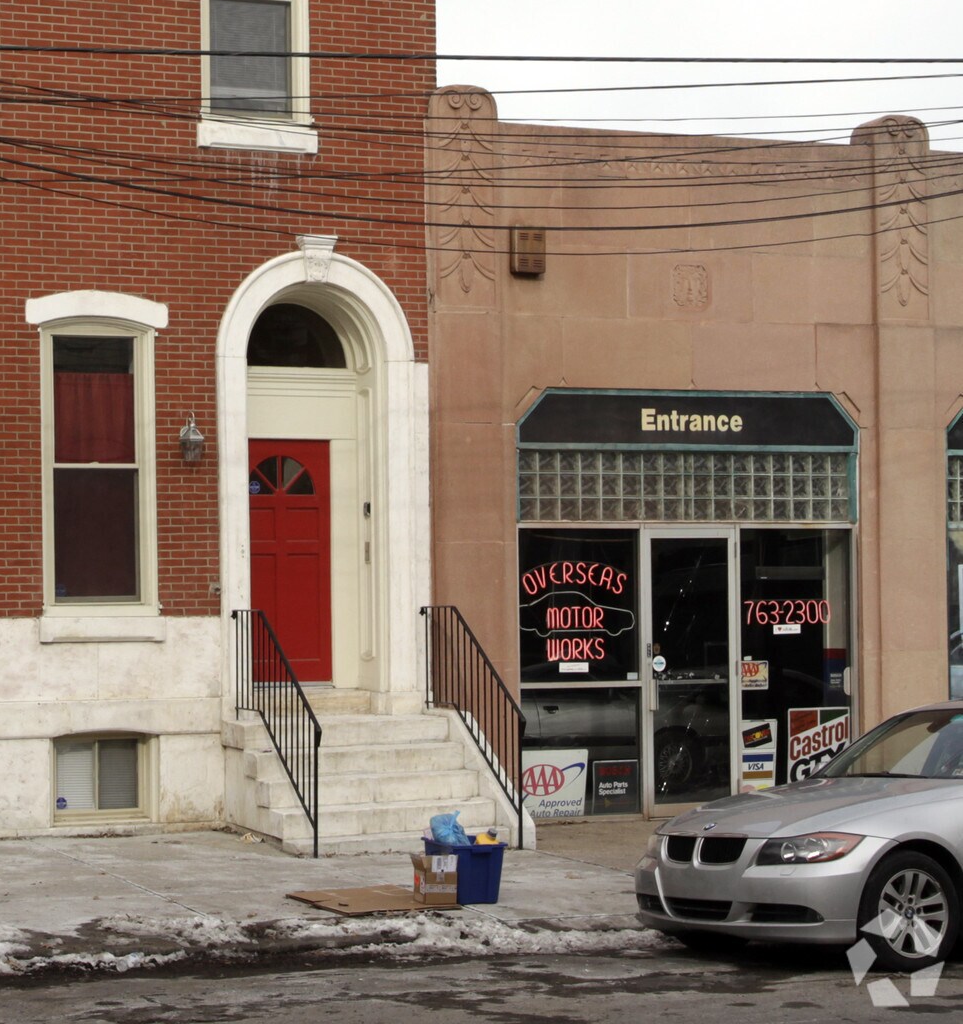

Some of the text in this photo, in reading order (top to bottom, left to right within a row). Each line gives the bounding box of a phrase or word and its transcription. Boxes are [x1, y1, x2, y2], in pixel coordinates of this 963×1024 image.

[641, 408, 743, 432] Entrance
[522, 561, 628, 595] OVERSEAS
[546, 606, 604, 629] MOTOR
[743, 600, 831, 625] 763-2300
[546, 638, 605, 661] WORKS
[789, 716, 849, 761] Castrol
[523, 764, 561, 796] AAA
[539, 798, 583, 809] Approved
[598, 788, 626, 796] Specialist
[530, 808, 581, 817] Auto Repair
